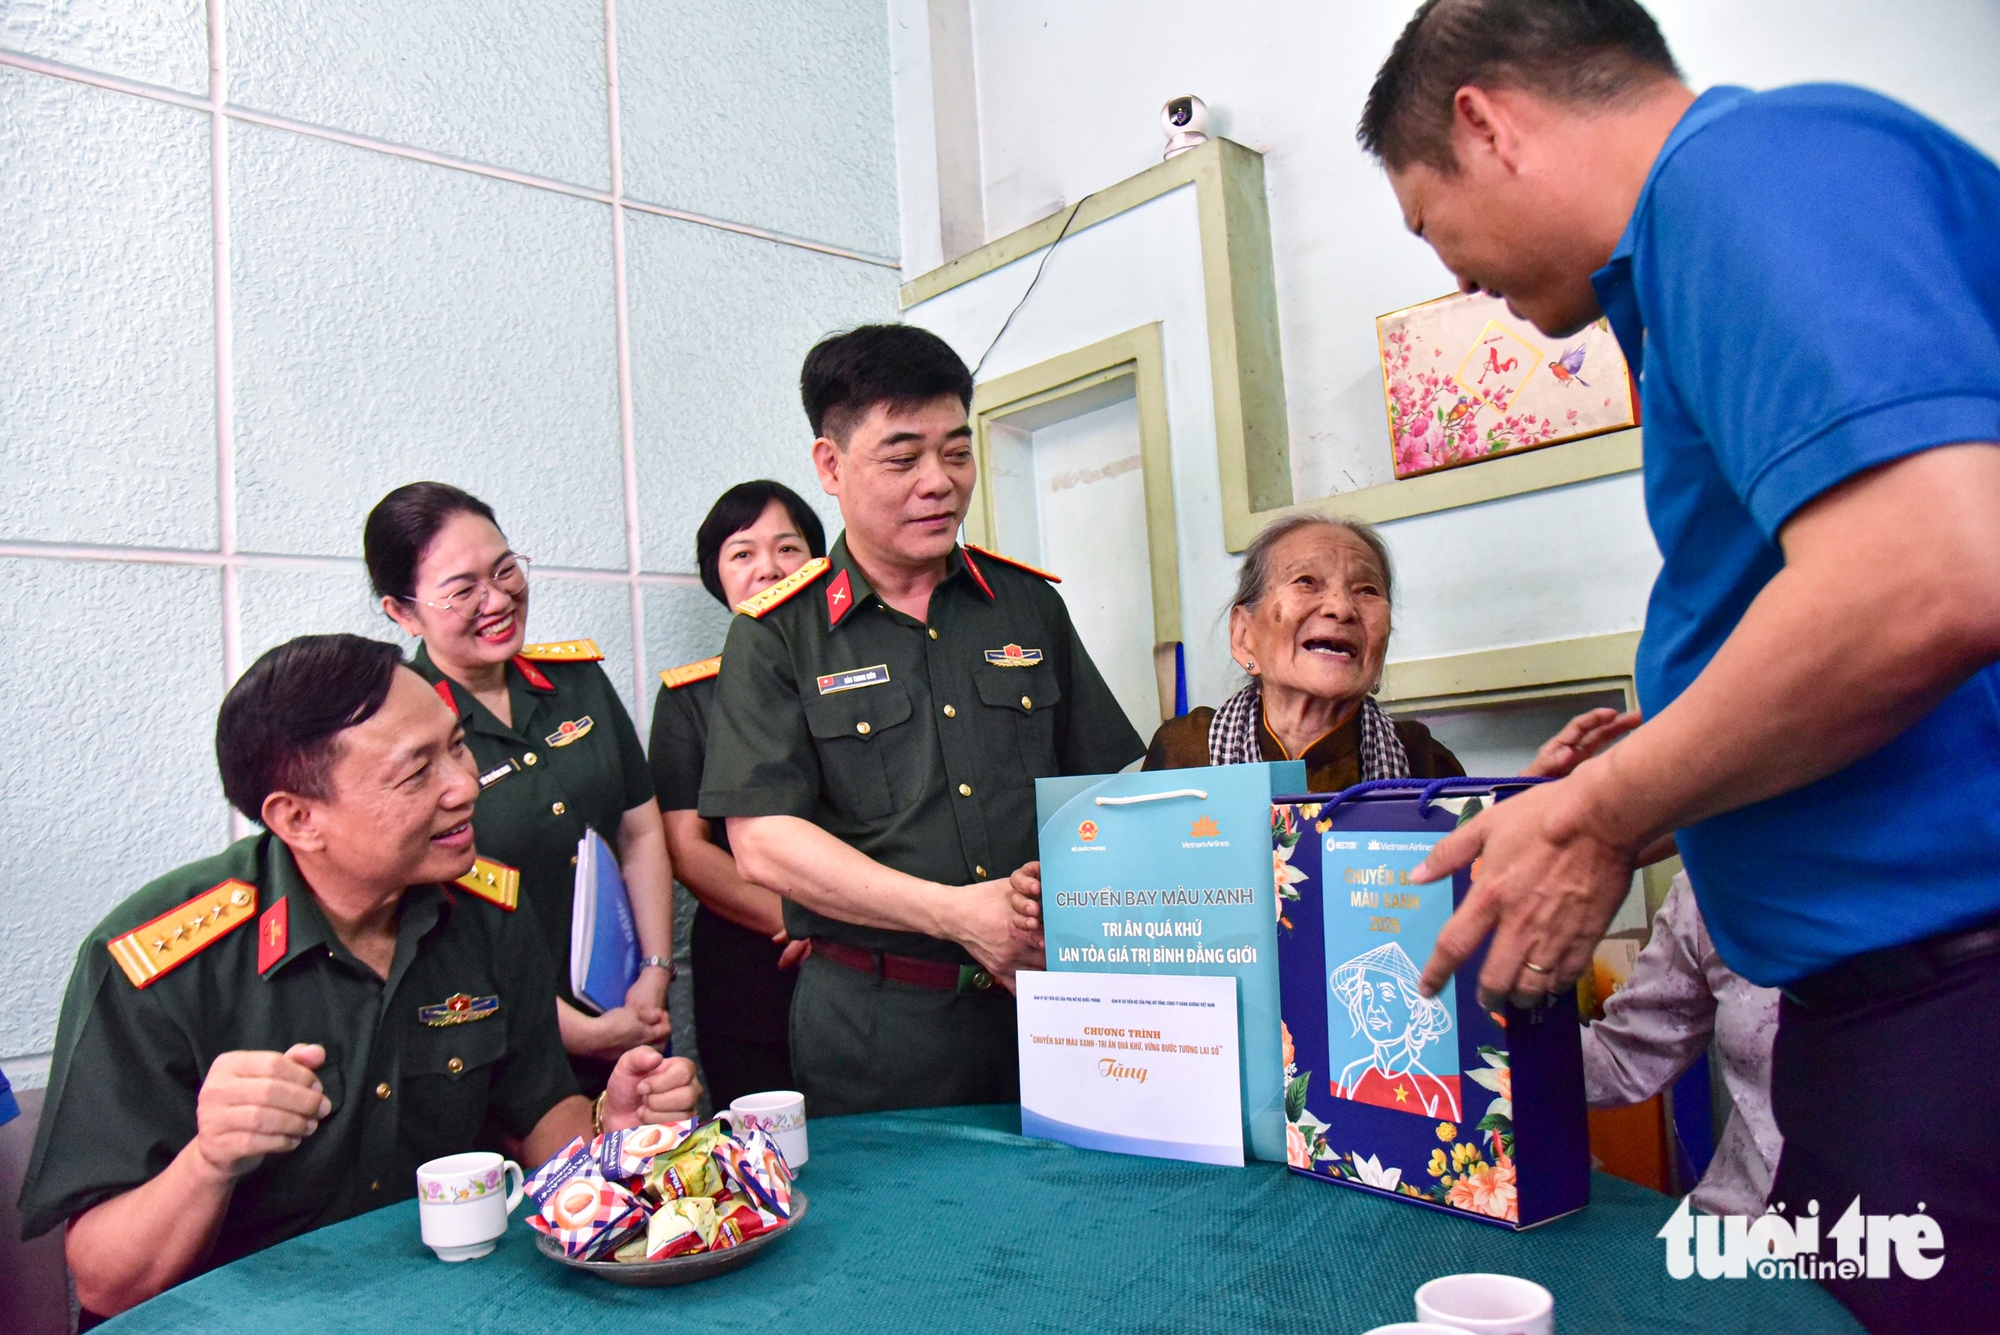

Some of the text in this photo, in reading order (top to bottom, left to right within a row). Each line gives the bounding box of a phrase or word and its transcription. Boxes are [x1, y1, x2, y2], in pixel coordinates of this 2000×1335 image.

[1344, 863, 1394, 886] CHUYẾN
[1056, 885, 1255, 908] CHUYẾN BAY MÀU XANH
[1350, 887, 1420, 910] MÀU XANH
[1102, 918, 1203, 939] TRI ÂN QUÁ KHỨ
[1058, 941, 1257, 966] LAN TỎA GIÁ TRỊ BÌNH ĐẲNG GIỚI
[1128, 1027, 1161, 1039] TRÌNH
[1054, 1037, 1064, 1045] BAY
[1065, 1037, 1078, 1047] MÀU
[1079, 1039, 1095, 1048] XANH
[1098, 1039, 1107, 1048] TRI
[1108, 1039, 1116, 1049] ÂN
[1117, 1040, 1129, 1050] QUÁ
[1199, 1046, 1209, 1055] LAI
[1097, 1057, 1150, 1084] Tặng
